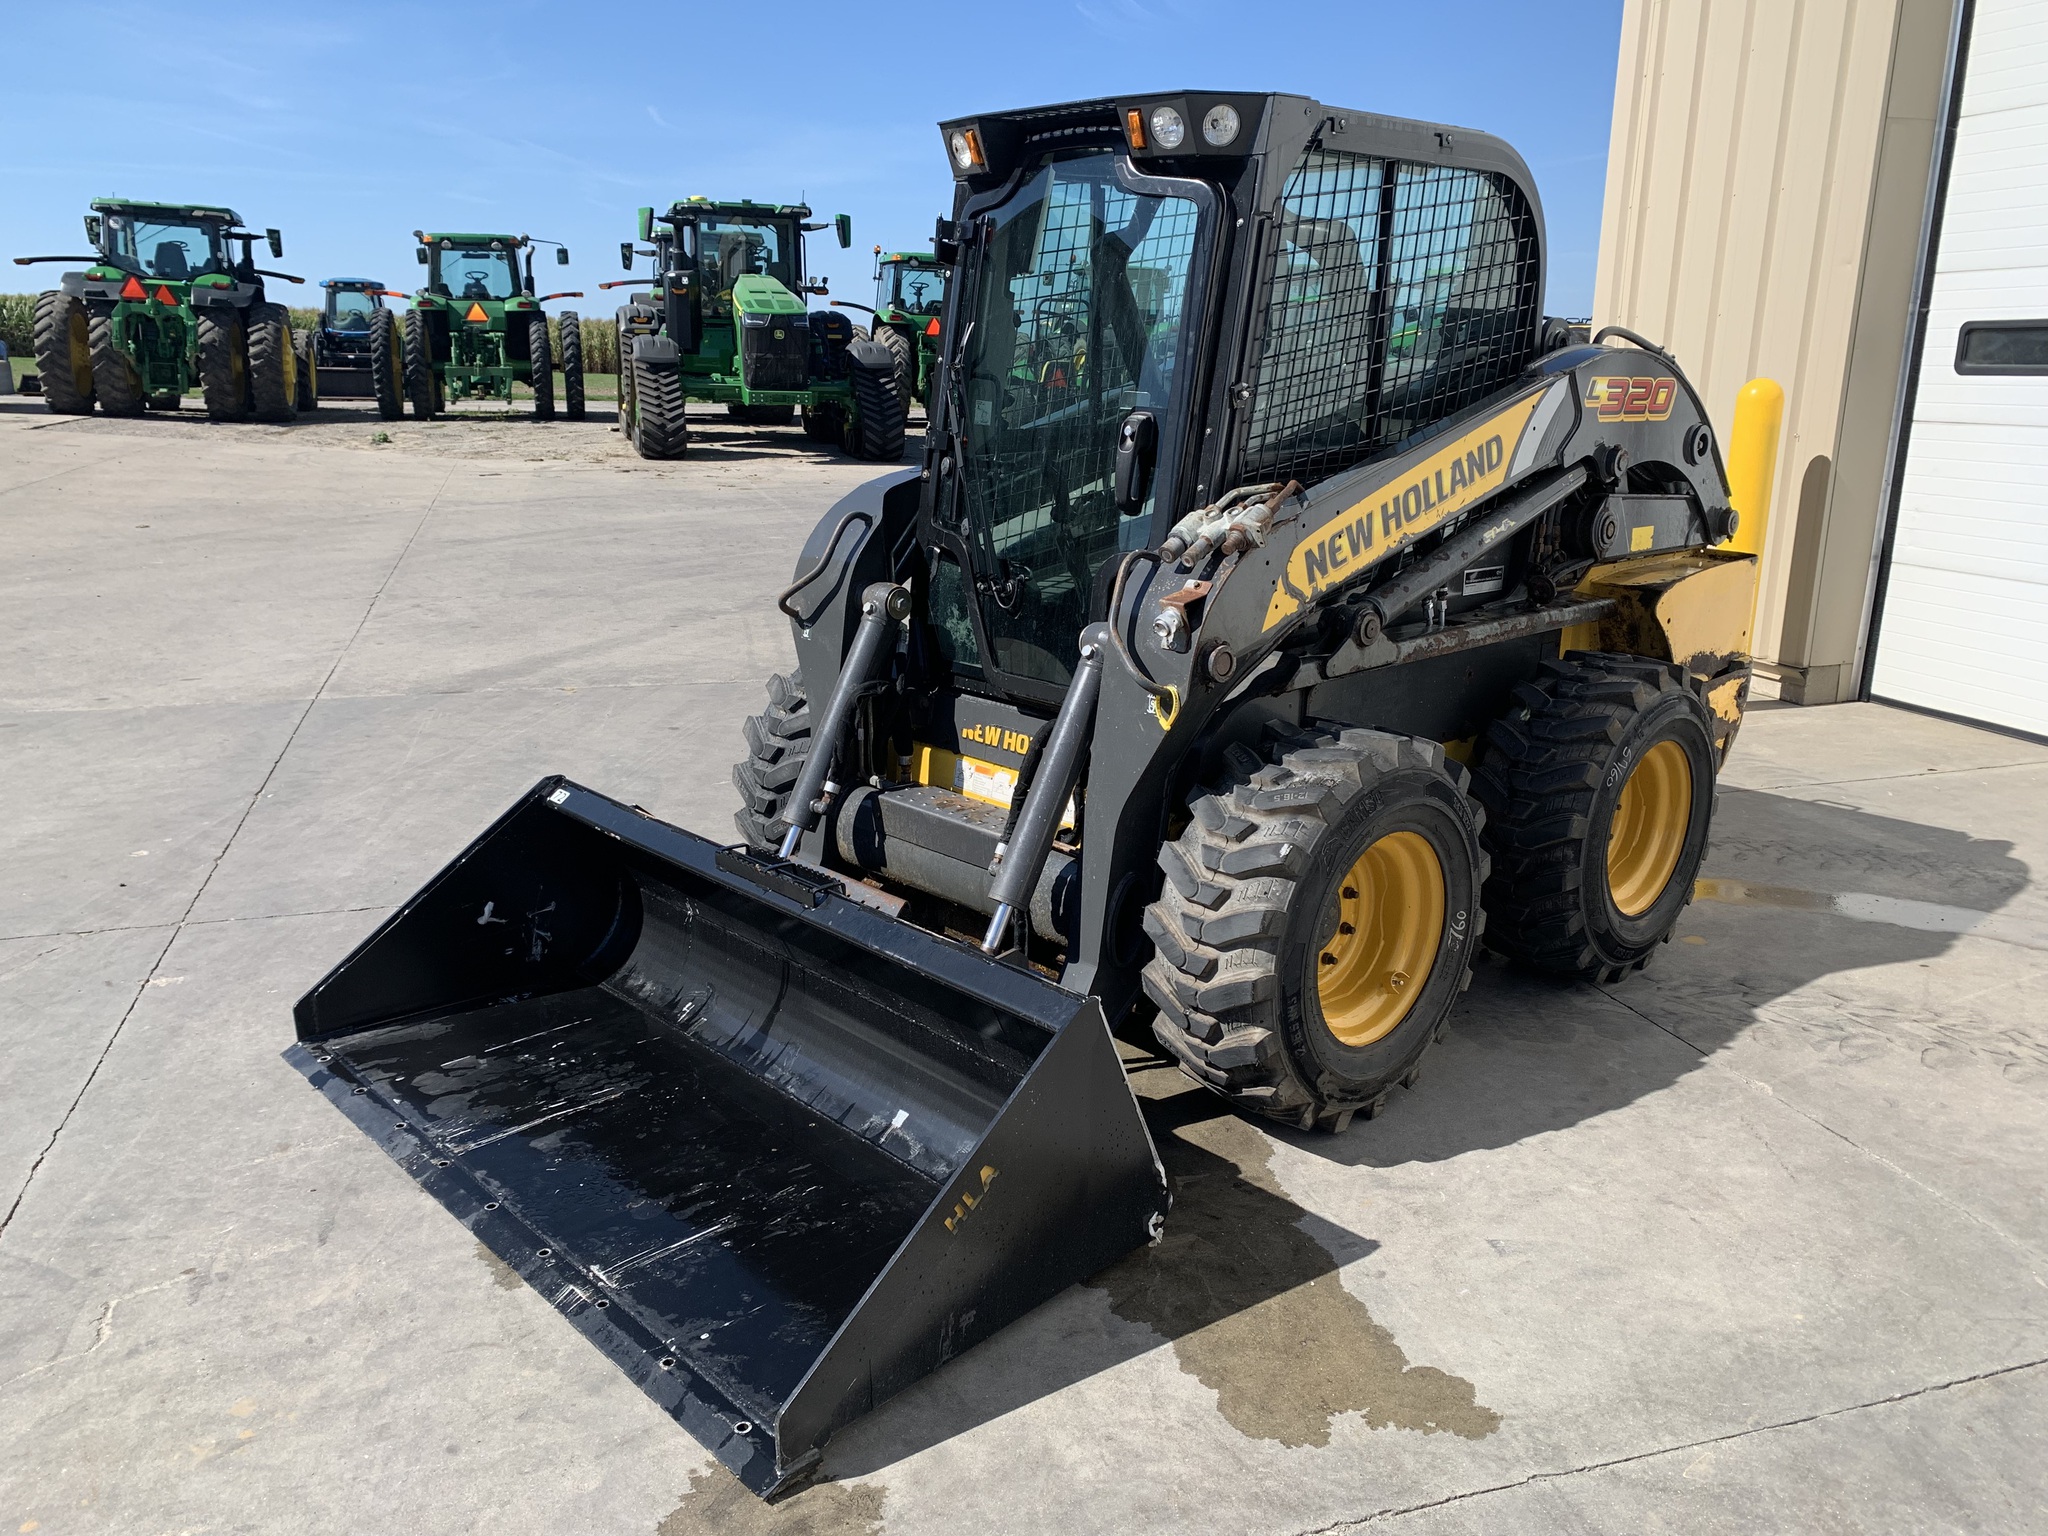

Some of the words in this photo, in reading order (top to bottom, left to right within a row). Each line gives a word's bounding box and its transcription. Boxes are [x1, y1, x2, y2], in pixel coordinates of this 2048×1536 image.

[1584, 377, 1678, 422] L320
[1303, 510, 1373, 586] NEW
[1379, 434, 1503, 538] HOLLAND
[962, 724, 1002, 747] NEW
[553, 790, 567, 803] 72
[1273, 791, 1309, 802] 12-16.5
[944, 1165, 1001, 1235] HLA
